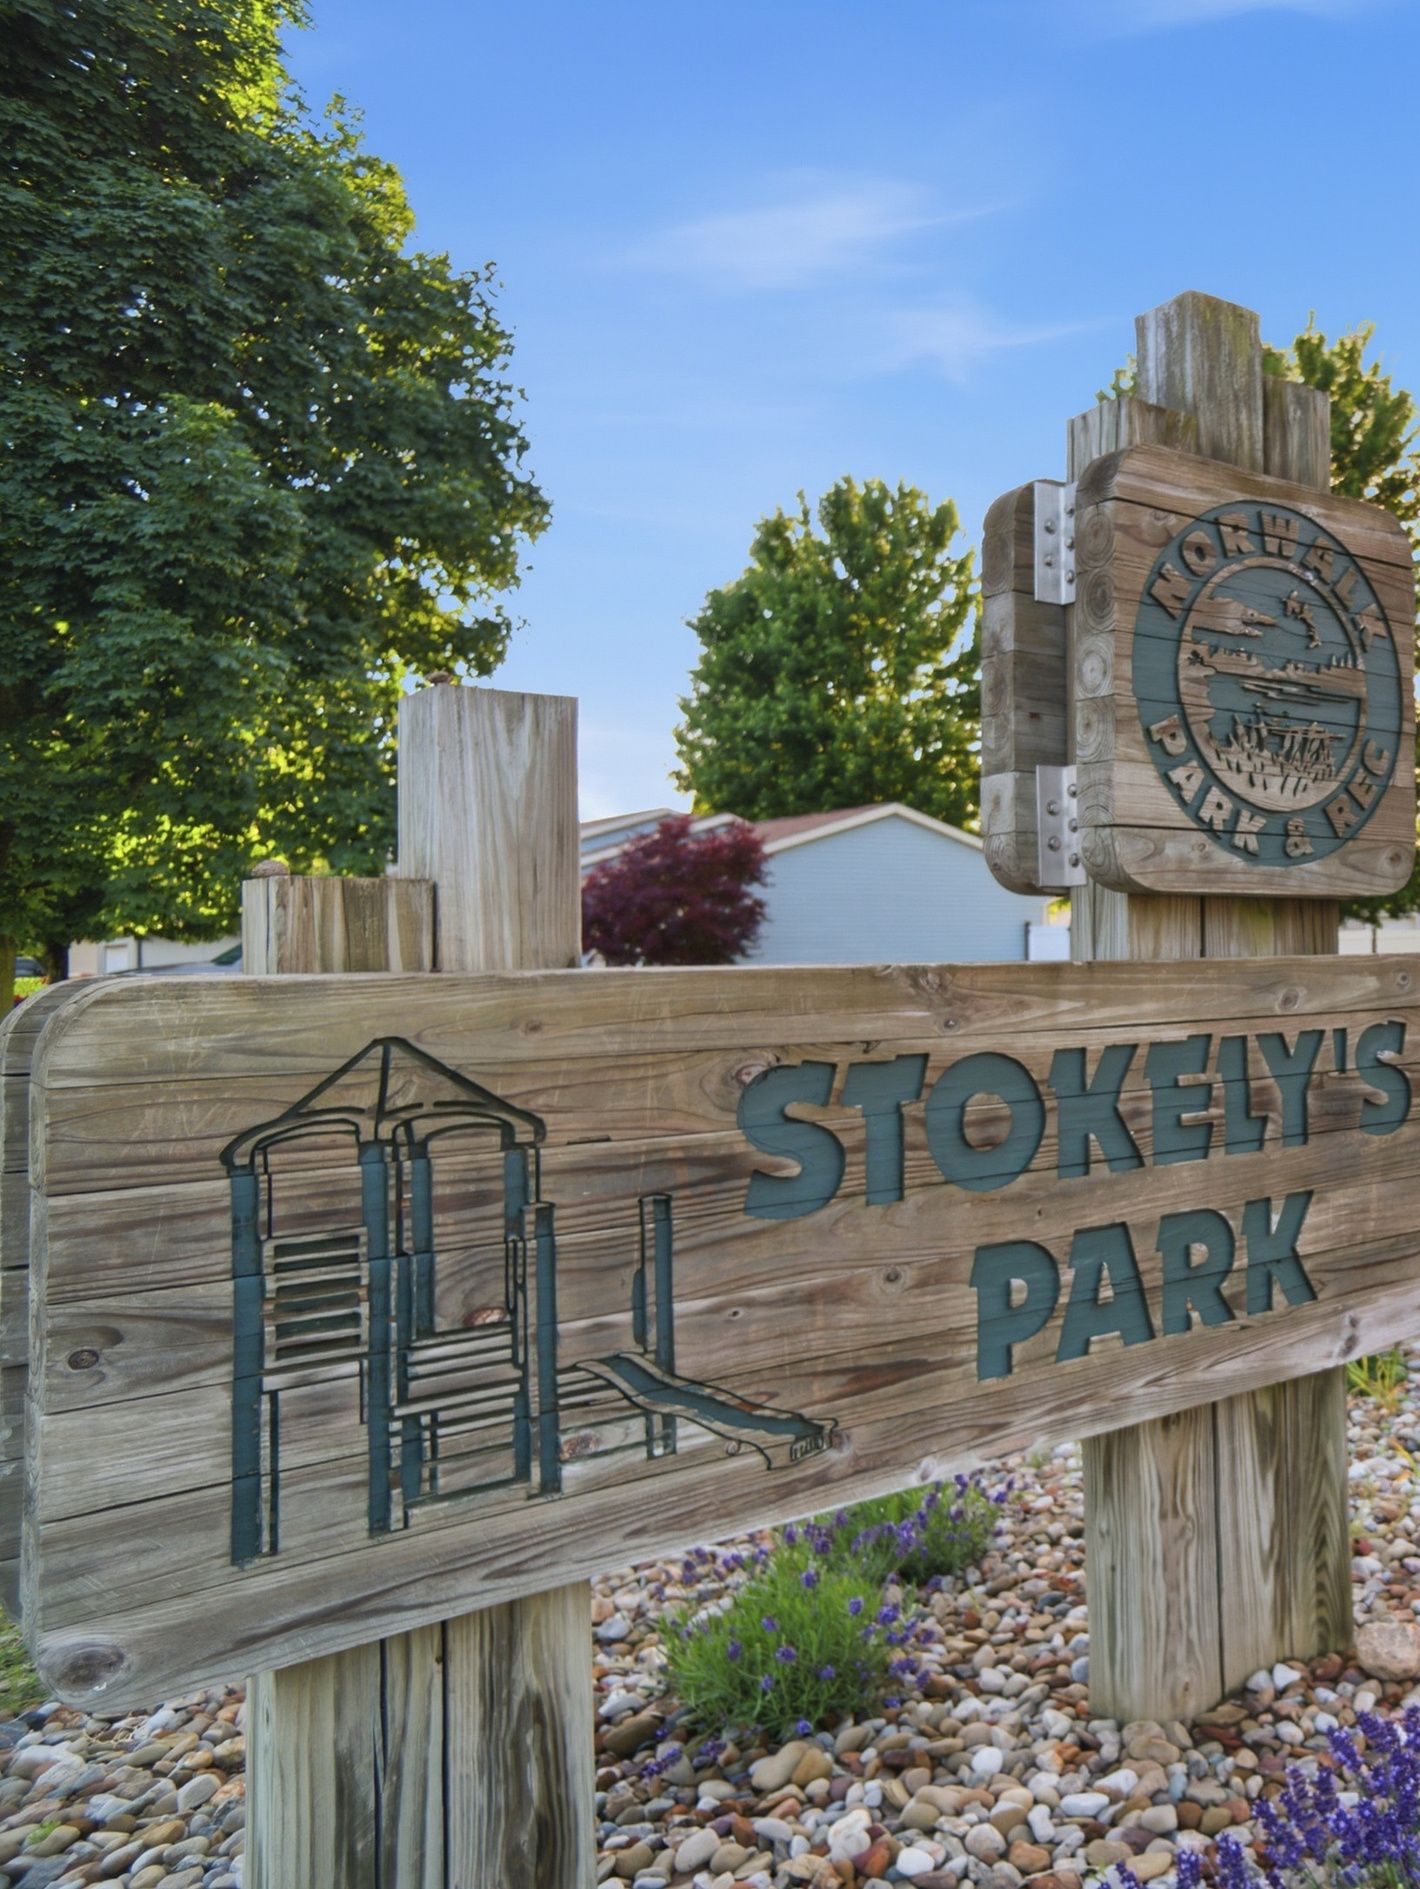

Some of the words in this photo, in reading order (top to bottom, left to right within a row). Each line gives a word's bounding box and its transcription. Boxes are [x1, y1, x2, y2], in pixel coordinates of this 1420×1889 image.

[1149, 510, 1388, 653] NORWALK
[1147, 714, 1266, 856] PARK
[1285, 817, 1314, 858] &
[1323, 738, 1389, 838] REC
[737, 1021, 1413, 1220] STOKELY'S
[970, 1190, 1319, 1382] PARK
